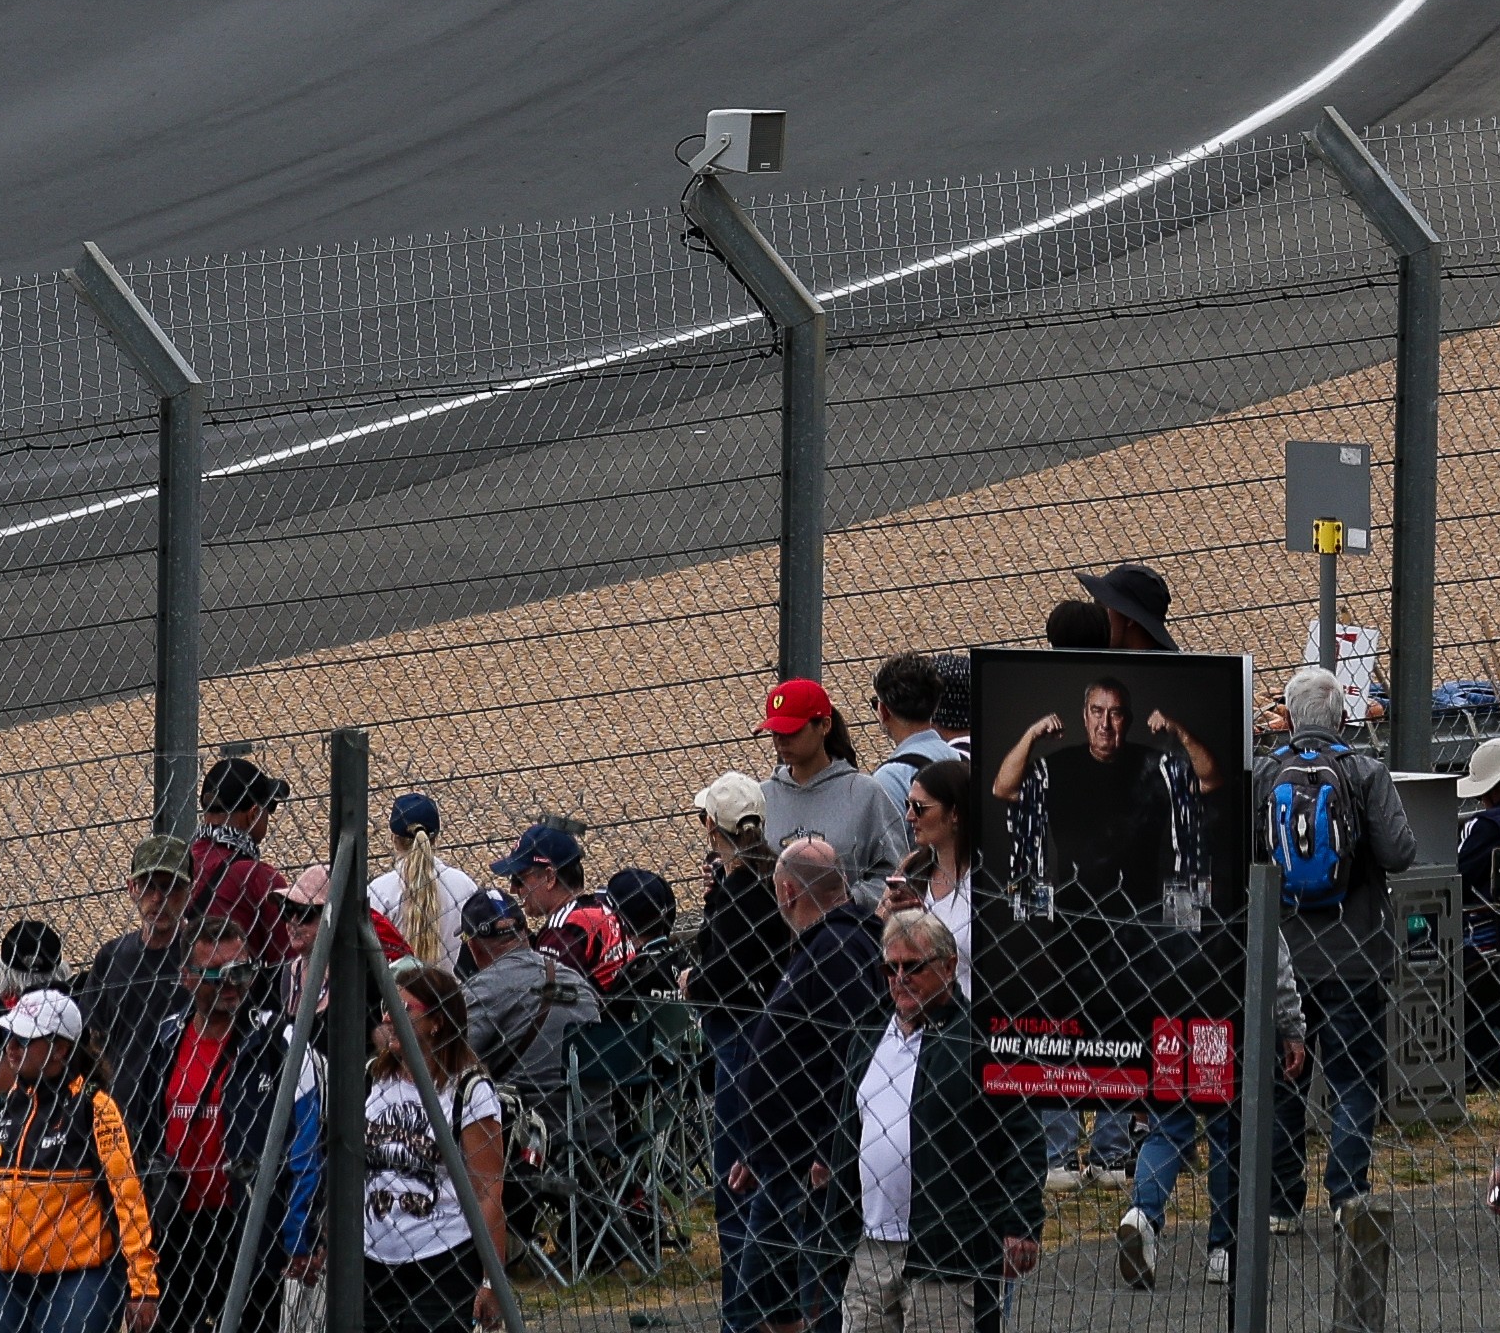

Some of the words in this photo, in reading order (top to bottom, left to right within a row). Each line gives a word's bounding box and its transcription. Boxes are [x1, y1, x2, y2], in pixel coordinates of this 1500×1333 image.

[990, 1035, 1021, 1054] UNE
[1024, 1033, 1072, 1056] MÊME
[1074, 1037, 1144, 1060] PASSION
